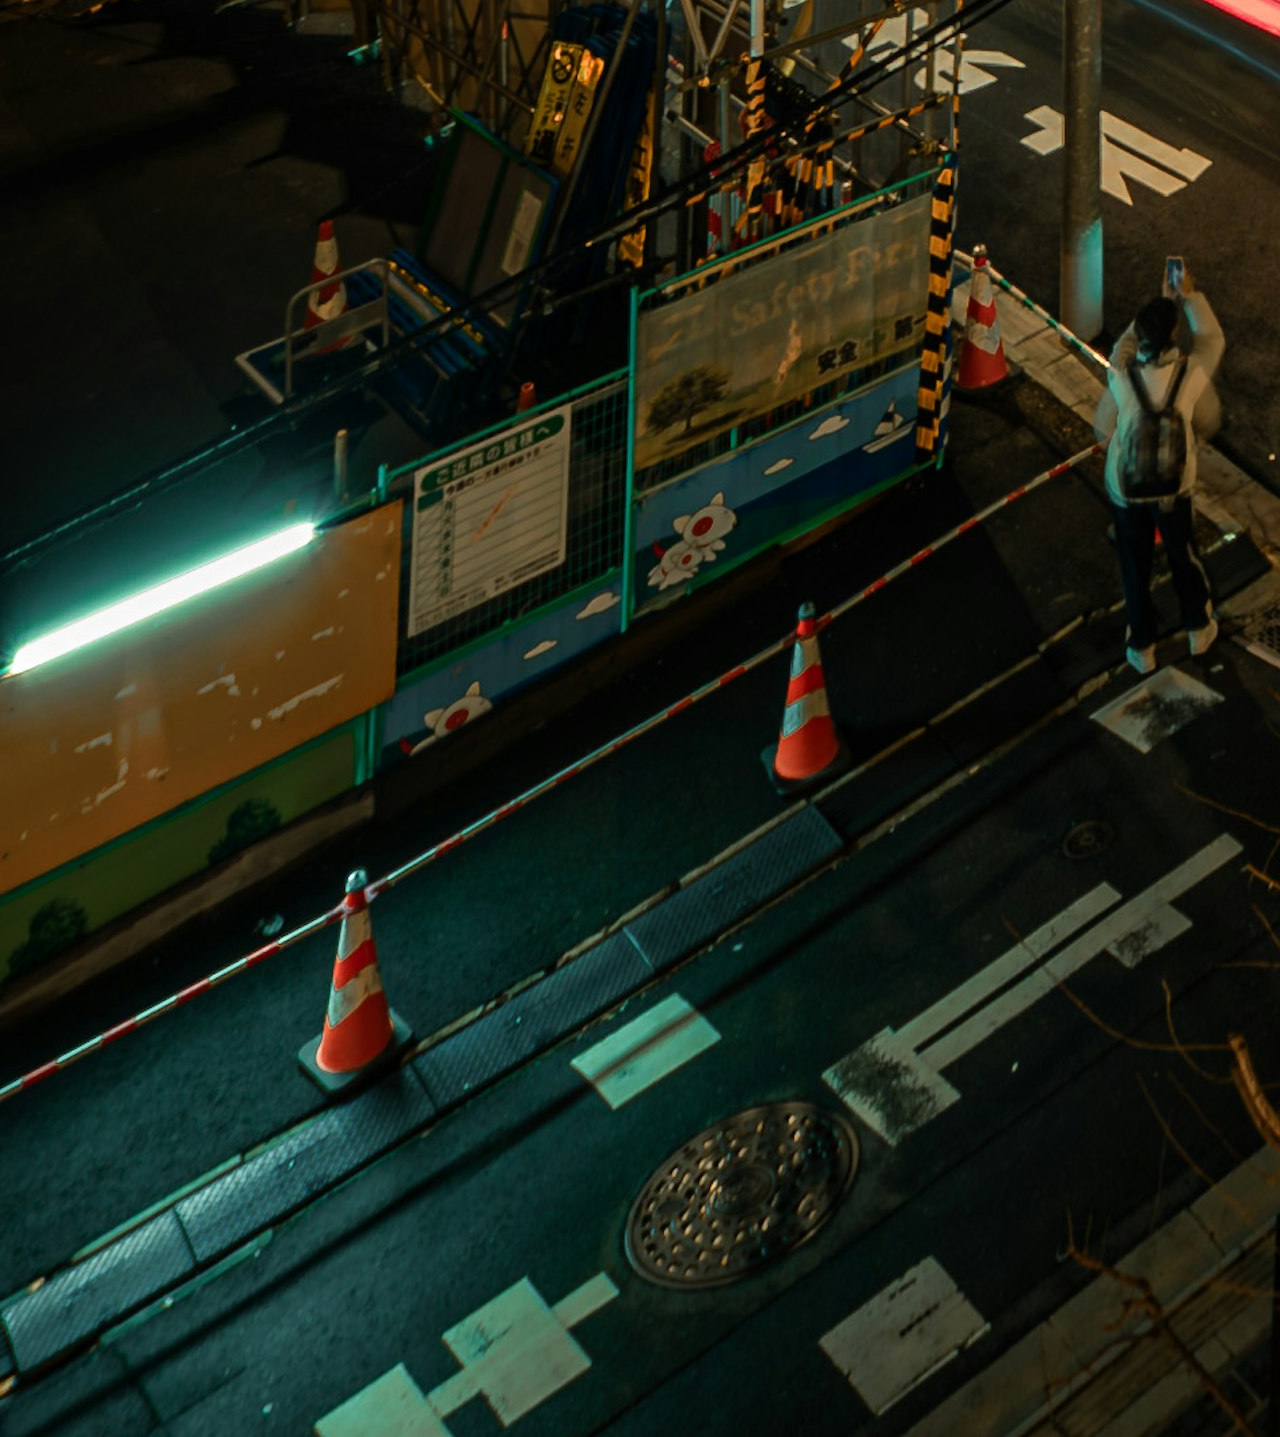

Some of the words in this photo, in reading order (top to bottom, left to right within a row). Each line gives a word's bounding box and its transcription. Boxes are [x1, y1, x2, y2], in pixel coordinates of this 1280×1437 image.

[730, 270, 835, 338] Safety
[817, 340, 858, 375] 安全
[436, 426, 550, 485] ご近隣の皆様へ
